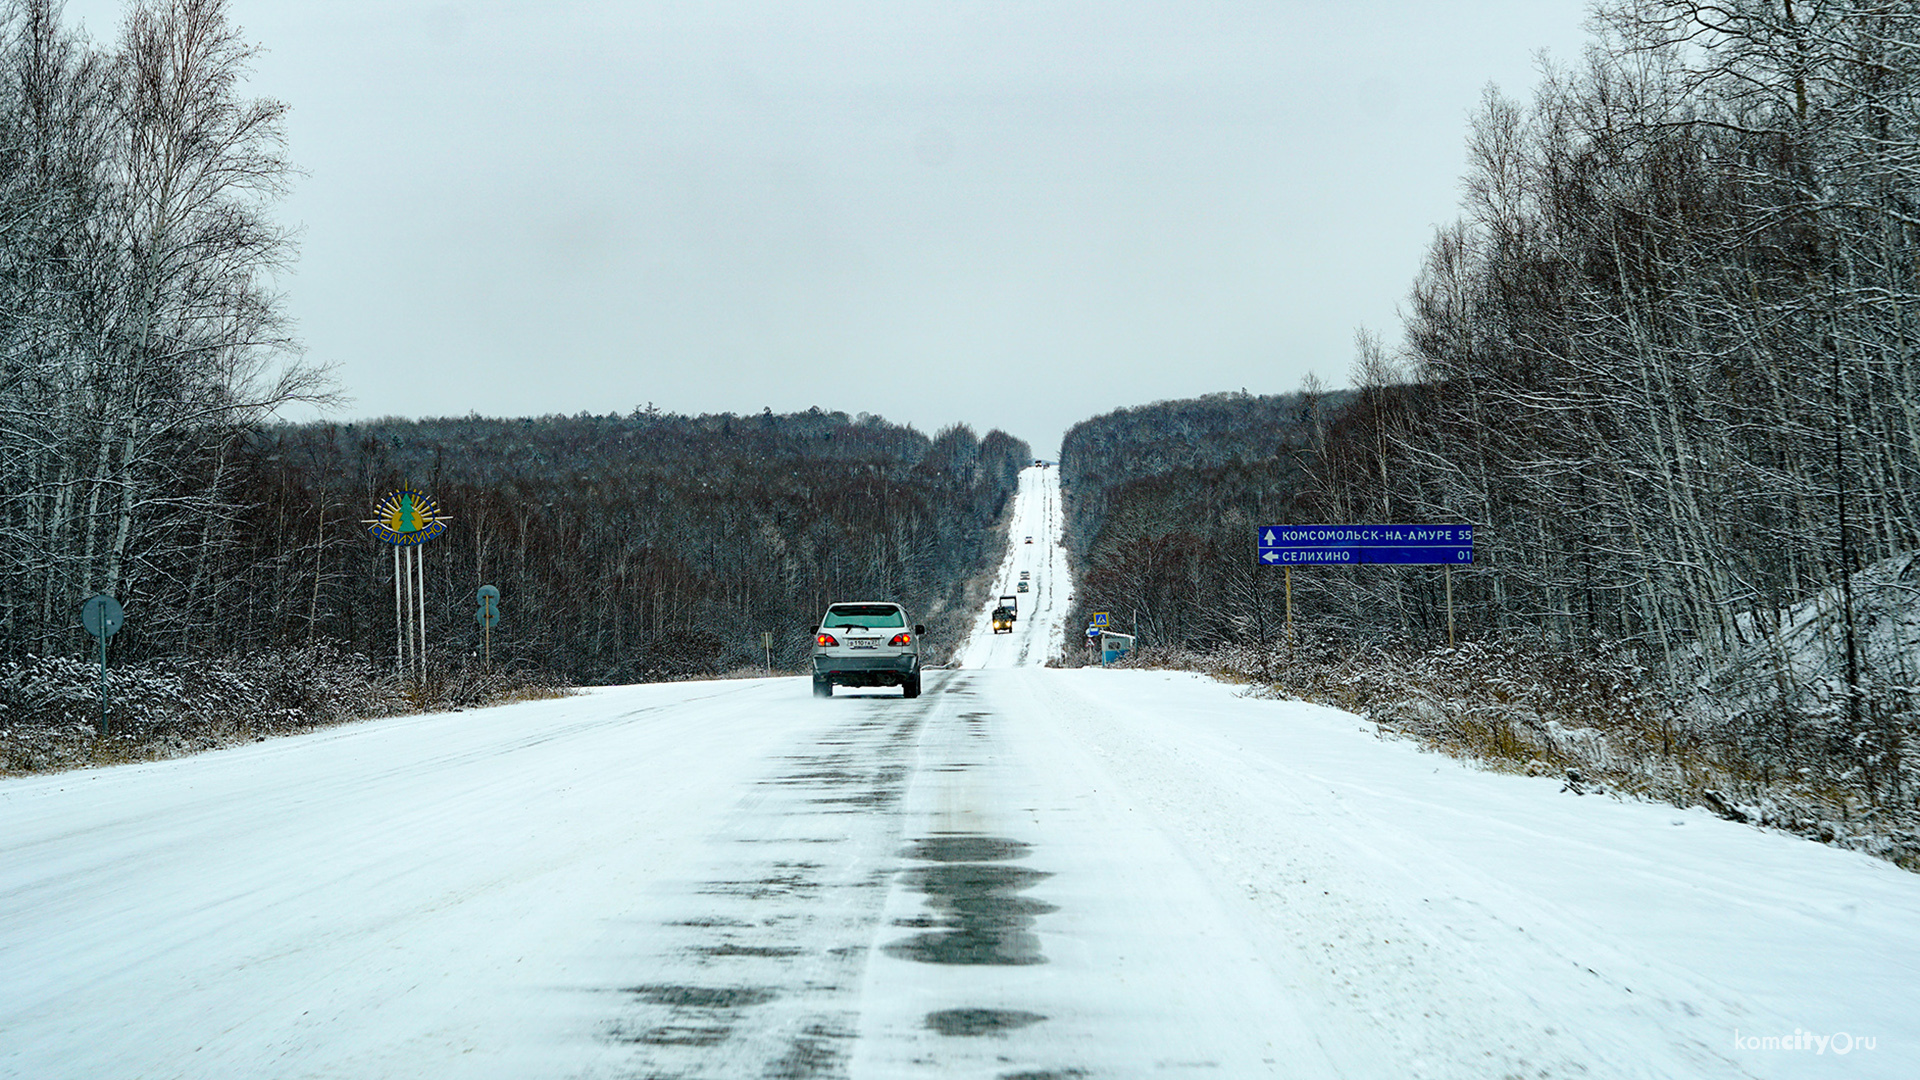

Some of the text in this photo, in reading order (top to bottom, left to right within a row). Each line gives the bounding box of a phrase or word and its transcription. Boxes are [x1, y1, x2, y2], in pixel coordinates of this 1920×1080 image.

[371, 522, 443, 544] СЕЛИХИНО
[1282, 530, 1472, 541] КОМСОМОЛЬСК-НА-АМУРЕ 55
[1282, 551, 1471, 562] СЕЛИХИНО 01
